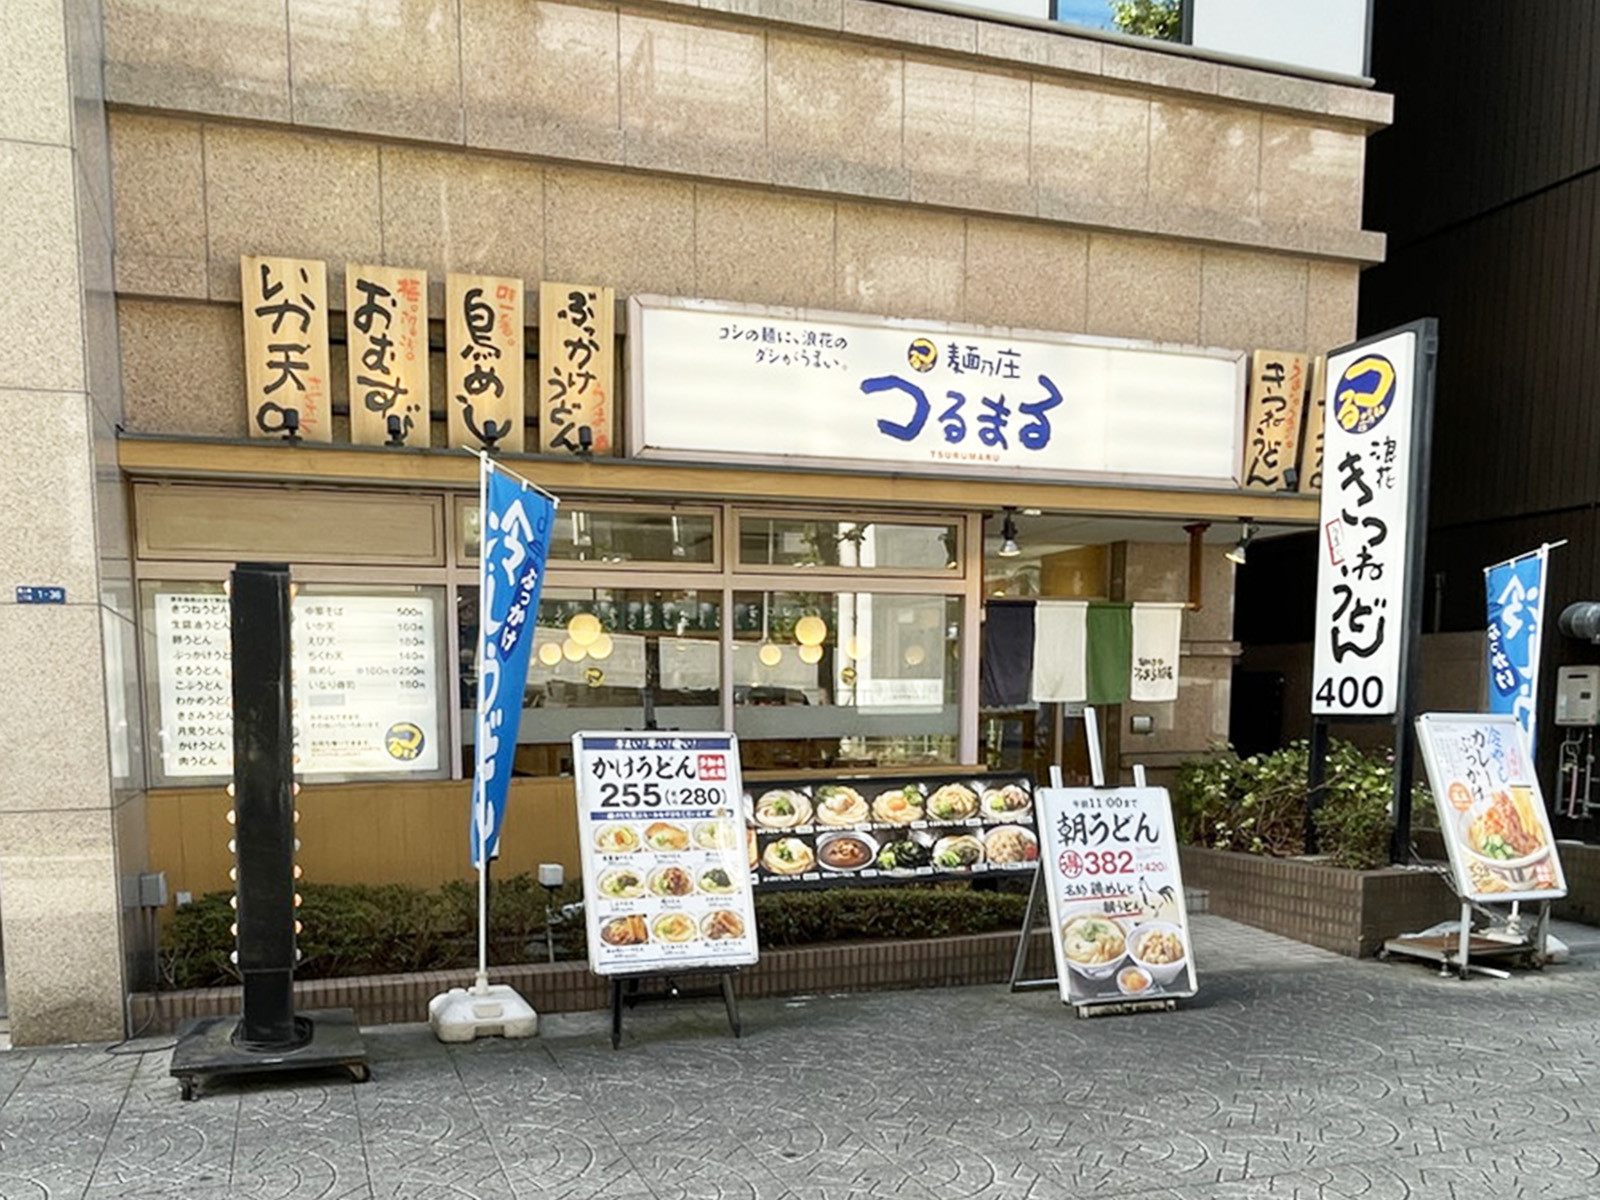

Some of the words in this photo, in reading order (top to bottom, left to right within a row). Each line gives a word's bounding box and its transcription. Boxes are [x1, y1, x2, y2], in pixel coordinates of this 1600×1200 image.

[947, 342, 1021, 379] 麺乃庄
[859, 374, 1064, 451] つるまる
[929, 449, 1000, 462] TSURUMARU
[1370, 436, 1397, 489] 浪花
[1331, 451, 1387, 664] きつねうどん
[173, 650, 232, 660] ぶっかけうど
[1316, 676, 1384, 708] 400
[592, 754, 697, 780] かけうどん
[600, 782, 662, 808] 255
[1057, 811, 1160, 847] 朝うどん
[1084, 850, 1135, 875] 382
